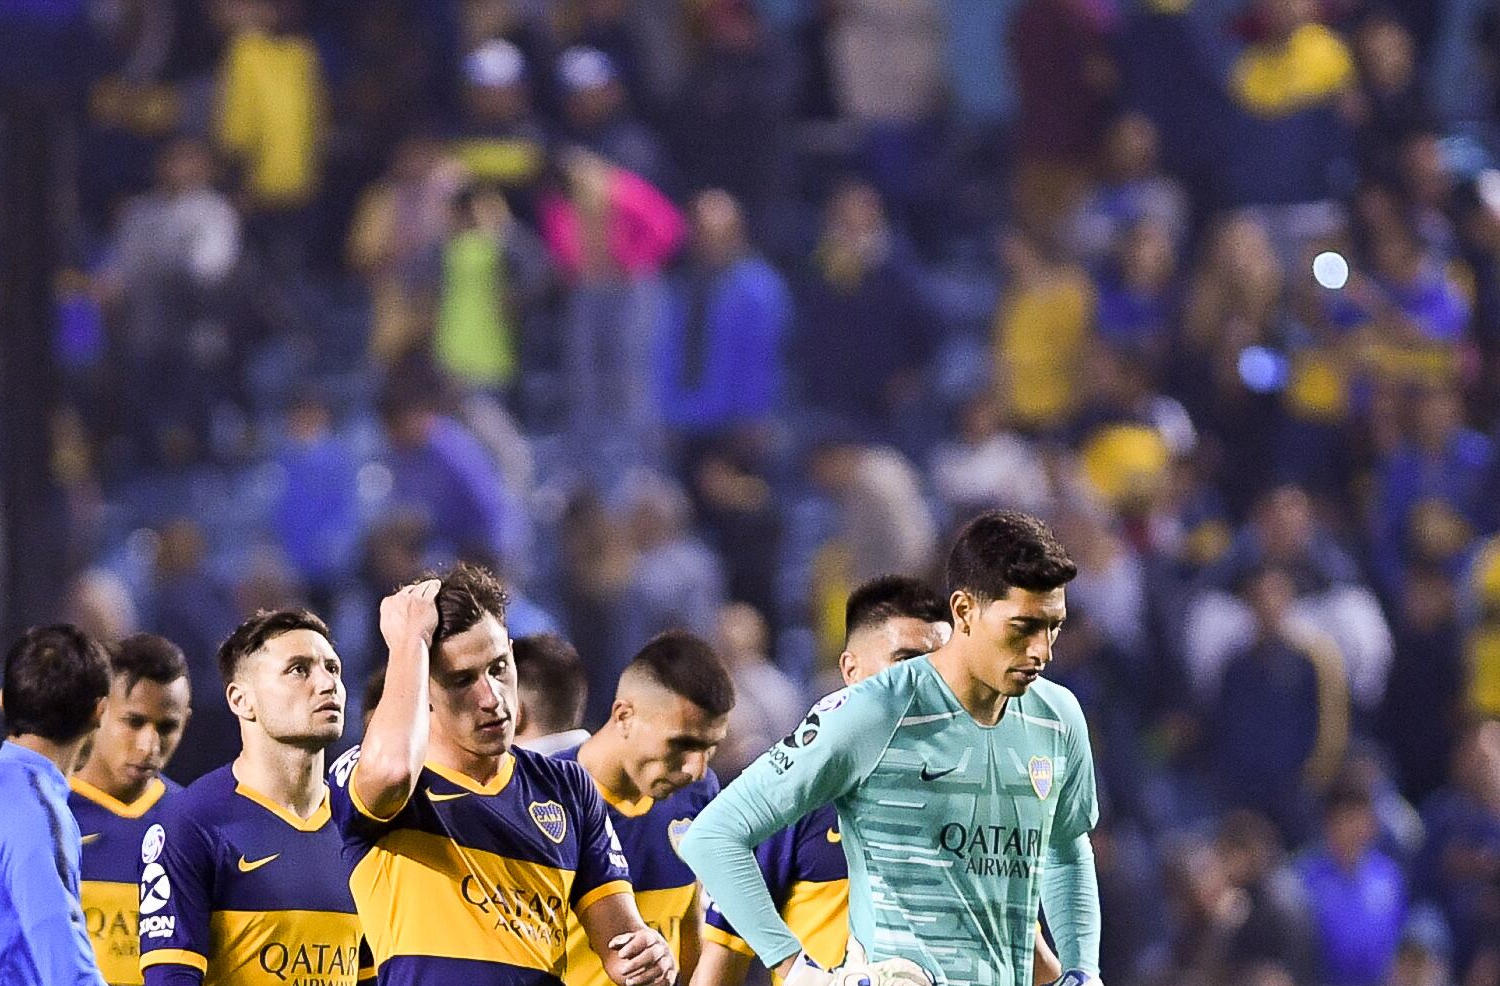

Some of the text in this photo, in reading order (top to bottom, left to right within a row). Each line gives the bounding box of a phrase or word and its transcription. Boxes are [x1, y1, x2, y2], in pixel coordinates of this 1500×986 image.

[941, 822, 1042, 859] QATAR
[965, 857, 1033, 879] AIRWAY
[259, 942, 357, 980] QATAR
